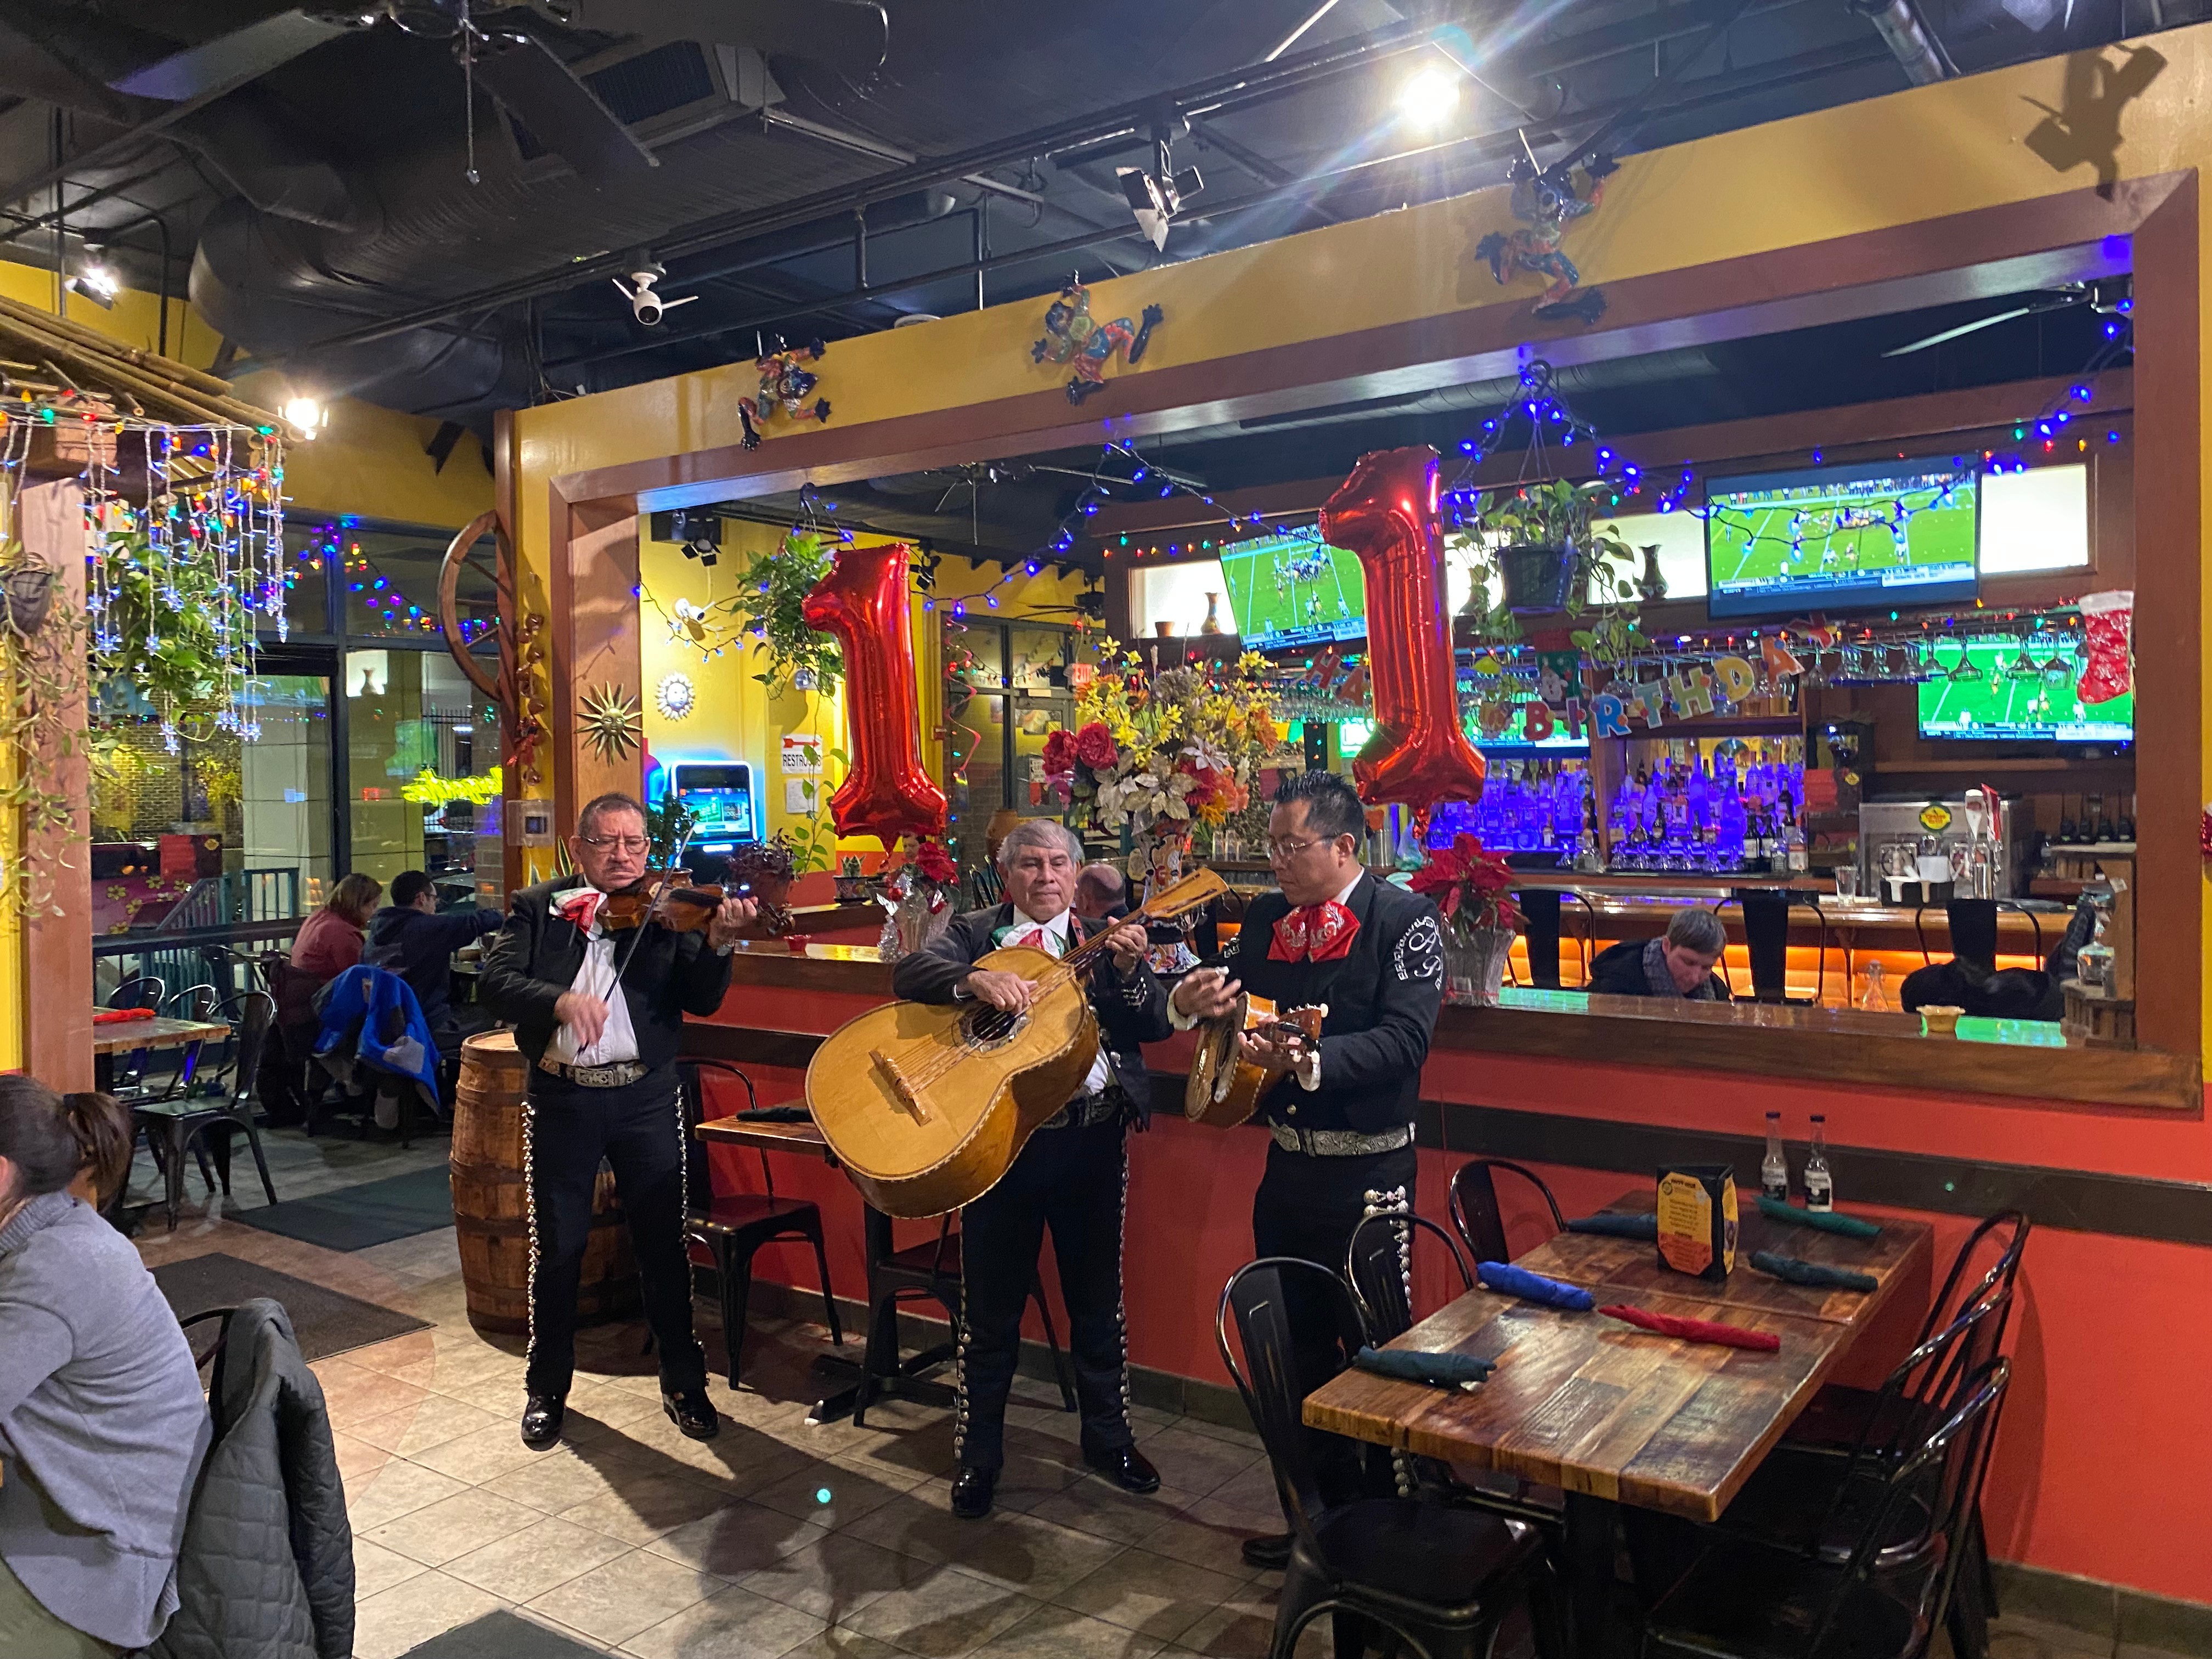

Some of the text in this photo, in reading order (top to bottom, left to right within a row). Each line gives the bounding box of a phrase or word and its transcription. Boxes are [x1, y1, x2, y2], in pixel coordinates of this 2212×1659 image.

[1075, 664, 1091, 683] EXIT
[1525, 611, 1836, 742] BIRTHDAY
[782, 754, 821, 766] RESTROS
